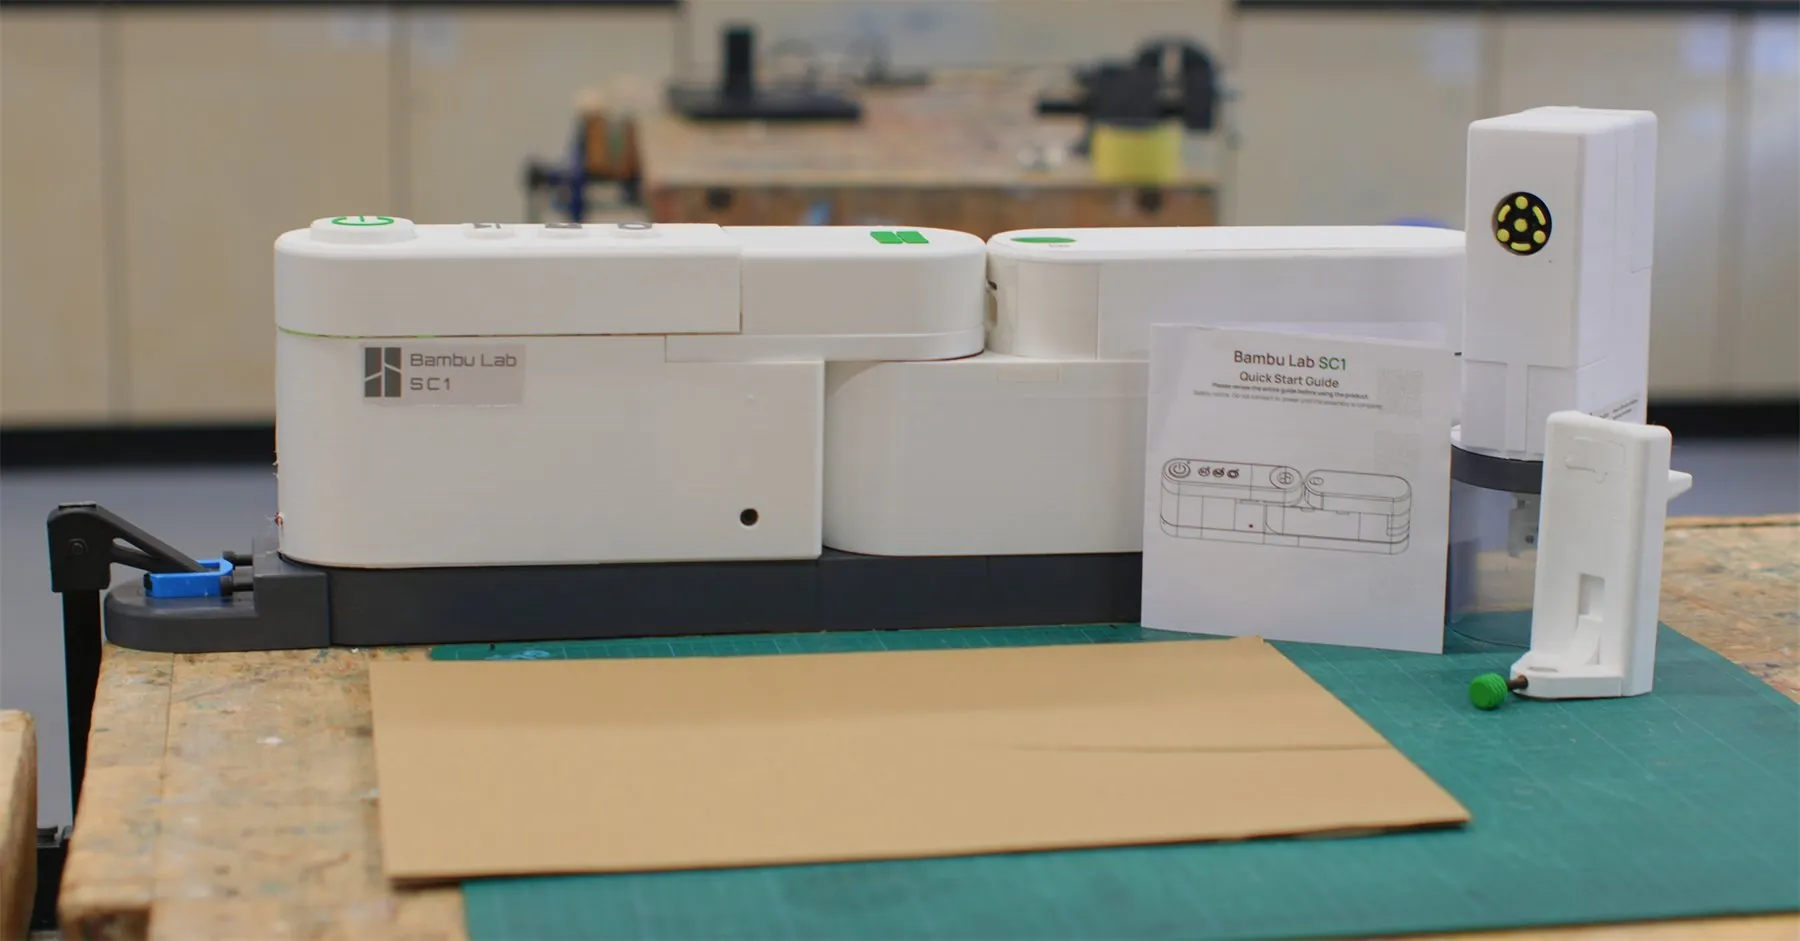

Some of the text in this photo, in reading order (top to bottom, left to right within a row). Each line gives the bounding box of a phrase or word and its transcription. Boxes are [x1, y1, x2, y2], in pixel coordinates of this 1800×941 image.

[410, 353, 517, 367] Bambu Lab
[1234, 350, 1346, 371] Bambu Lab SC1
[410, 377, 450, 391] SC1
[1239, 371, 1339, 388] Quick Start Guide
